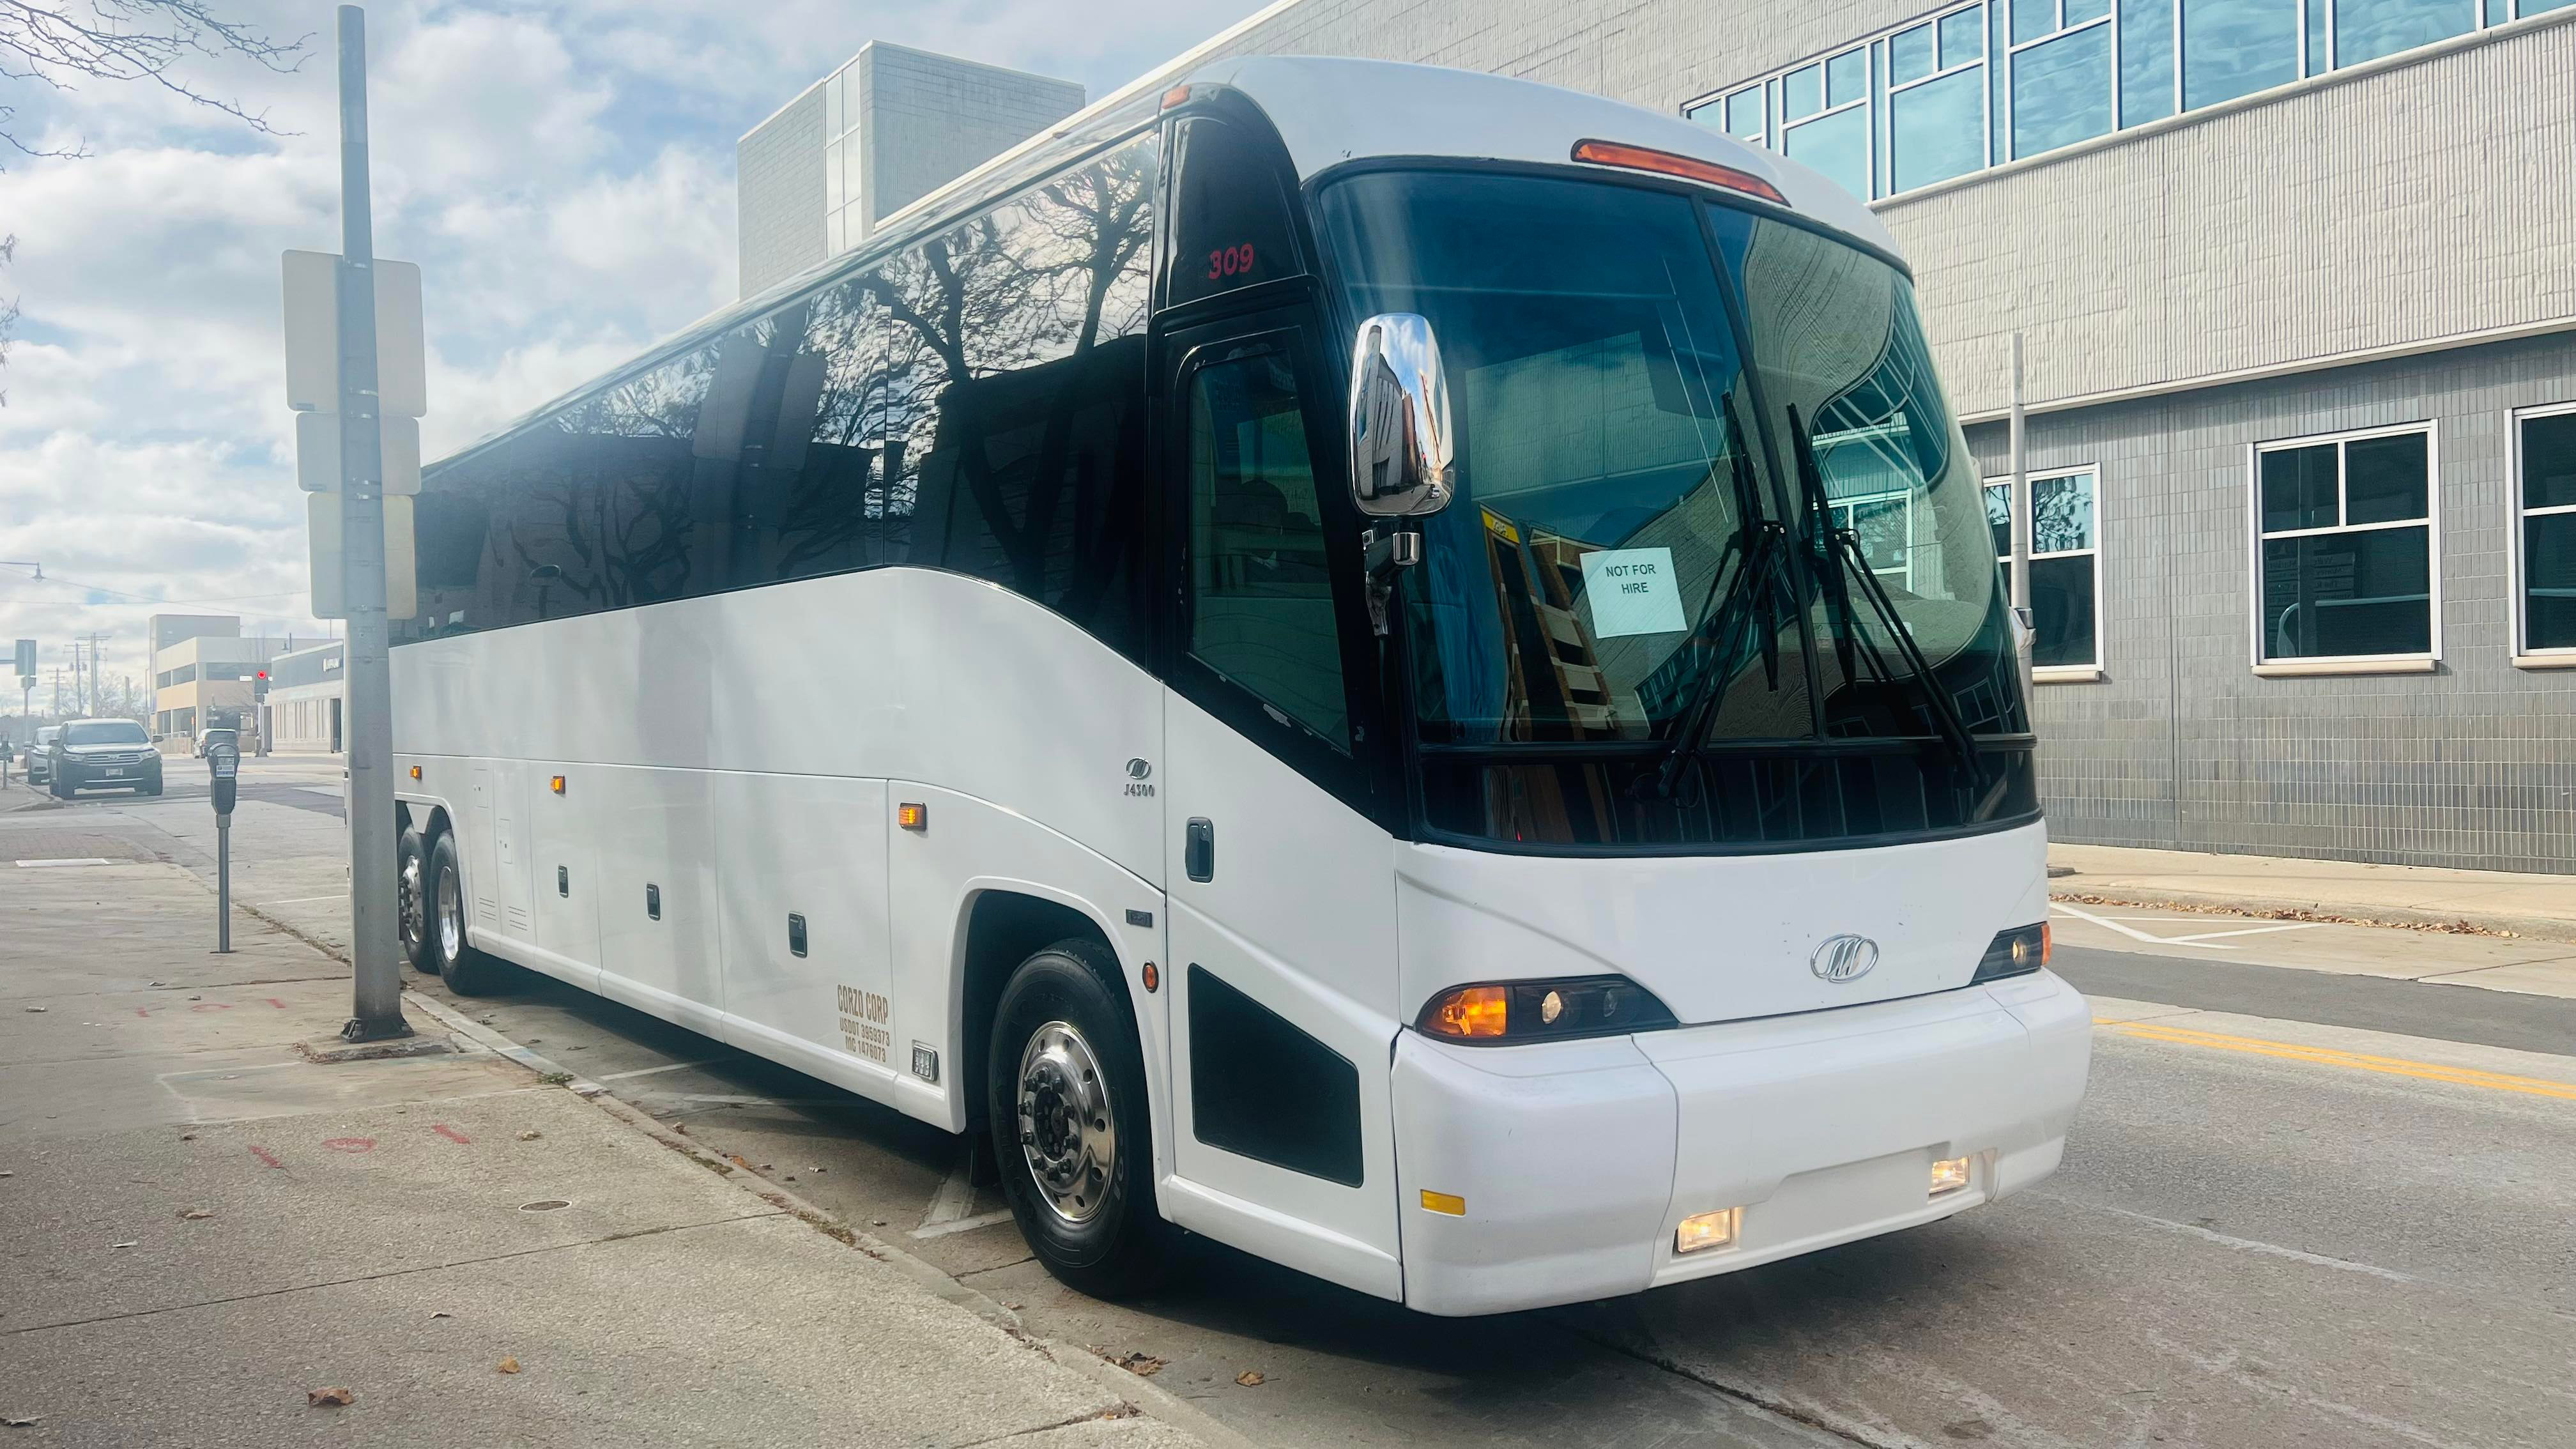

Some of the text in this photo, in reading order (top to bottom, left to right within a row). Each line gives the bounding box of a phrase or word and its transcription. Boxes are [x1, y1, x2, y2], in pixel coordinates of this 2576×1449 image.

[1208, 243, 1254, 280] 309
[1606, 564, 1657, 578] NOT FOR
[1621, 581, 1649, 595] HIRE
[837, 984, 888, 1025] CORZO CORP
[839, 1016, 890, 1047] USDOT 3959373
[845, 1035, 886, 1063] MC 1476073
